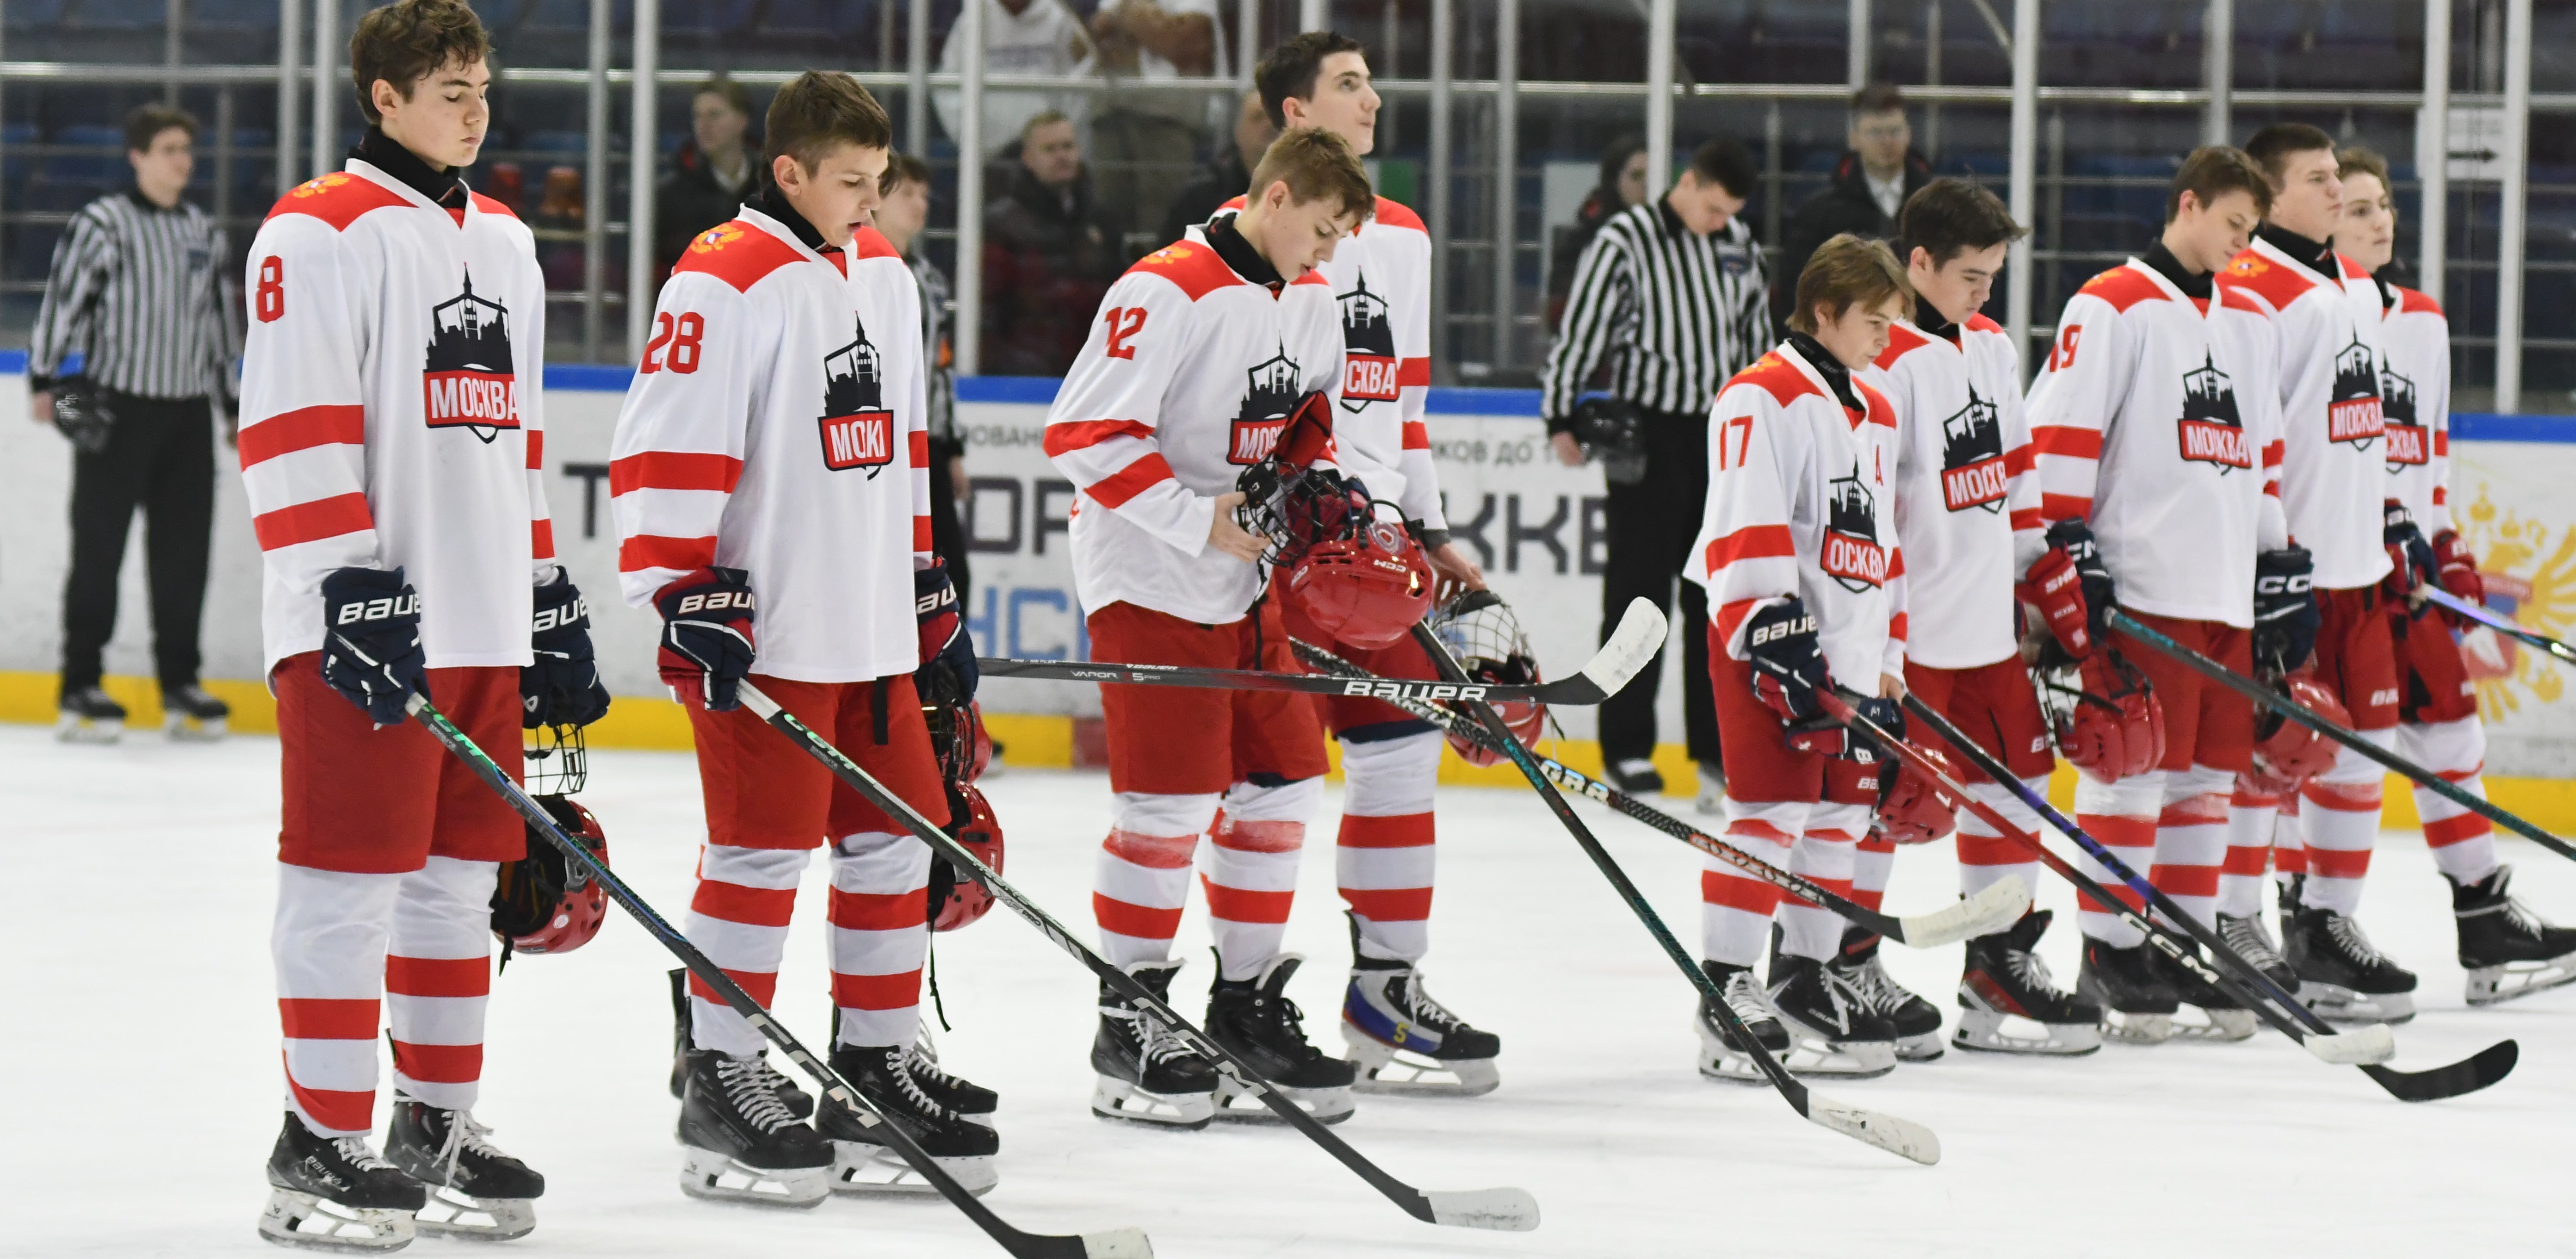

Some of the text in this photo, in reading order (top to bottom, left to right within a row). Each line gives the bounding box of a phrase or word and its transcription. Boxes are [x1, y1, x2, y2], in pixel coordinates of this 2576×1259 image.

[257, 255, 285, 323] 8
[640, 311, 704, 374] 28
[1104, 306, 1148, 361] 12
[430, 377, 520, 421] МОСКВА
[1345, 359, 1396, 396] СКВА
[1719, 415, 1753, 471] 17
[1948, 460, 2008, 506] МОСКВ
[1374, 559, 1406, 573] CCM
[1830, 539, 1884, 583] ОСКВА
[2258, 574, 2312, 595] CC
[1752, 615, 1817, 647] BAUE
[1071, 670, 1119, 679] VAPOR
[1344, 681, 1486, 702] BAUER
[784, 713, 859, 772] CCM
[2039, 801, 2136, 884] CCM
[615, 895, 658, 935] TRIGGER
[1021, 909, 1042, 927] PRO
[2119, 911, 2220, 986] CCM
[1132, 996, 1269, 1098] CCM
[1393, 1021, 1410, 1044] 5
[746, 1012, 882, 1129] CCM
